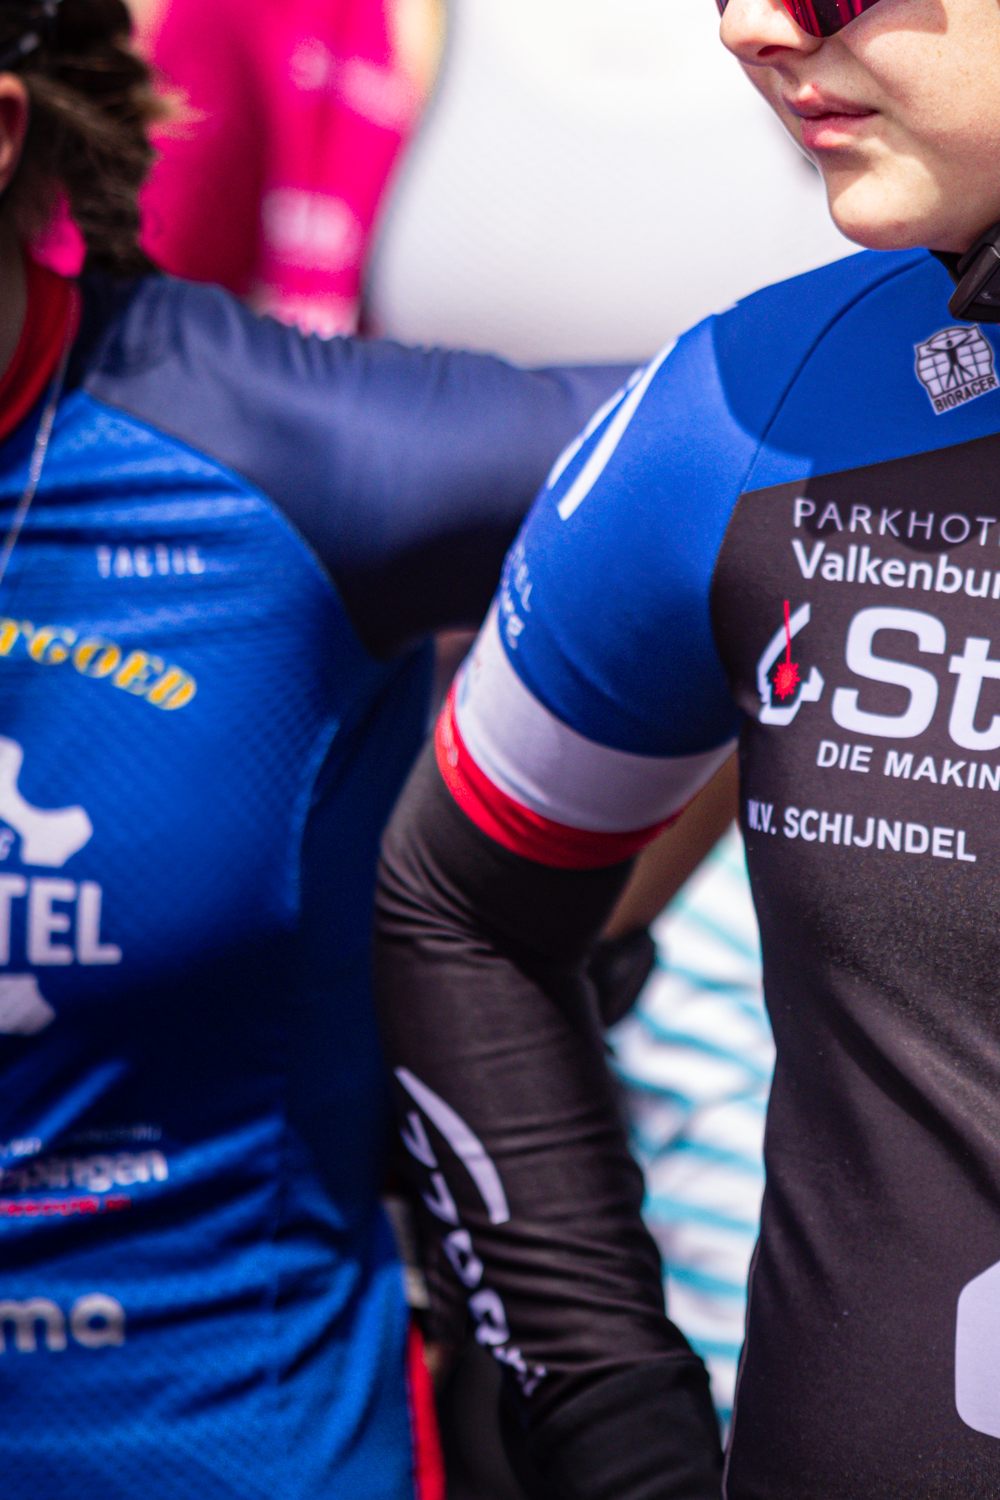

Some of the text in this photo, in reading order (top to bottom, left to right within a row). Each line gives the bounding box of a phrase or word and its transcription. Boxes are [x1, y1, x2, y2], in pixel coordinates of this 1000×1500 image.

[933, 375, 998, 413] BIORACER
[815, 739, 874, 773] DIE
[783, 806, 977, 863] SCHIJNDEL
